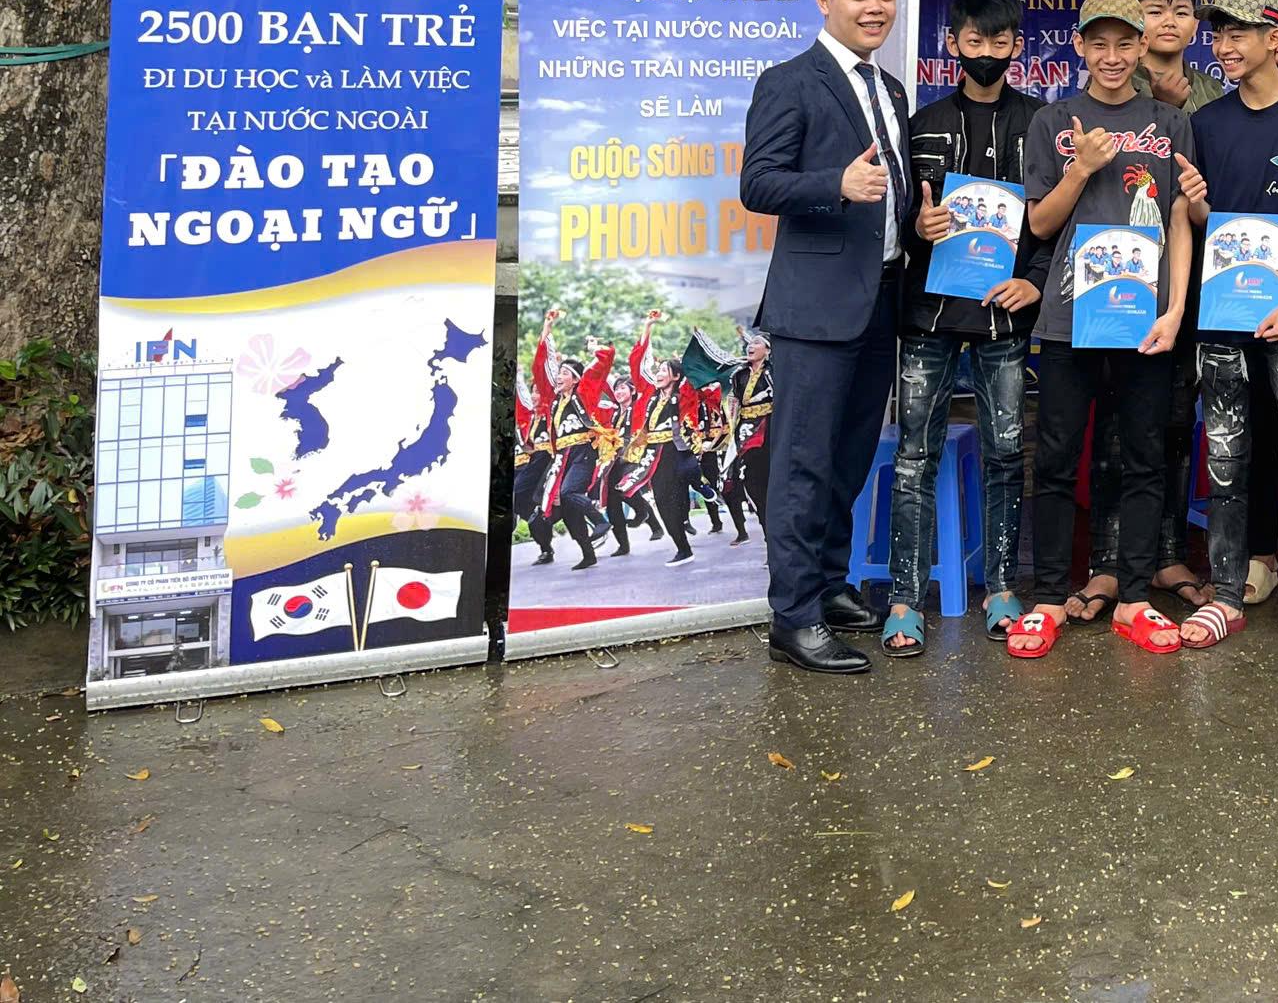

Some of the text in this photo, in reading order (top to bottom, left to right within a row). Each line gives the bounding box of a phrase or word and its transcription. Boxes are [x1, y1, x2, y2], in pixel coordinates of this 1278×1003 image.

[138, 4, 476, 53] 2500 BẠN TRẺ
[553, 16, 802, 43] VIỆC TẠI NƯỚC NGOÀI.
[144, 64, 470, 93] ĐI DU HỌC và LÀM VIỆC
[538, 55, 625, 79] NHỮNG
[690, 57, 774, 81] NGHIỆM
[917, 57, 965, 87] NH
[1006, 55, 1070, 87] BẢN
[188, 107, 428, 135] TẠI NƯỚC NGOÀI
[640, 94, 722, 117] SẼ LÀM
[322, 152, 434, 195] TẠO
[570, 137, 640, 187] CUỘC
[646, 135, 716, 177] SỐNG
[128, 208, 322, 251] NGOẠI
[560, 199, 774, 262] PHONG PH
